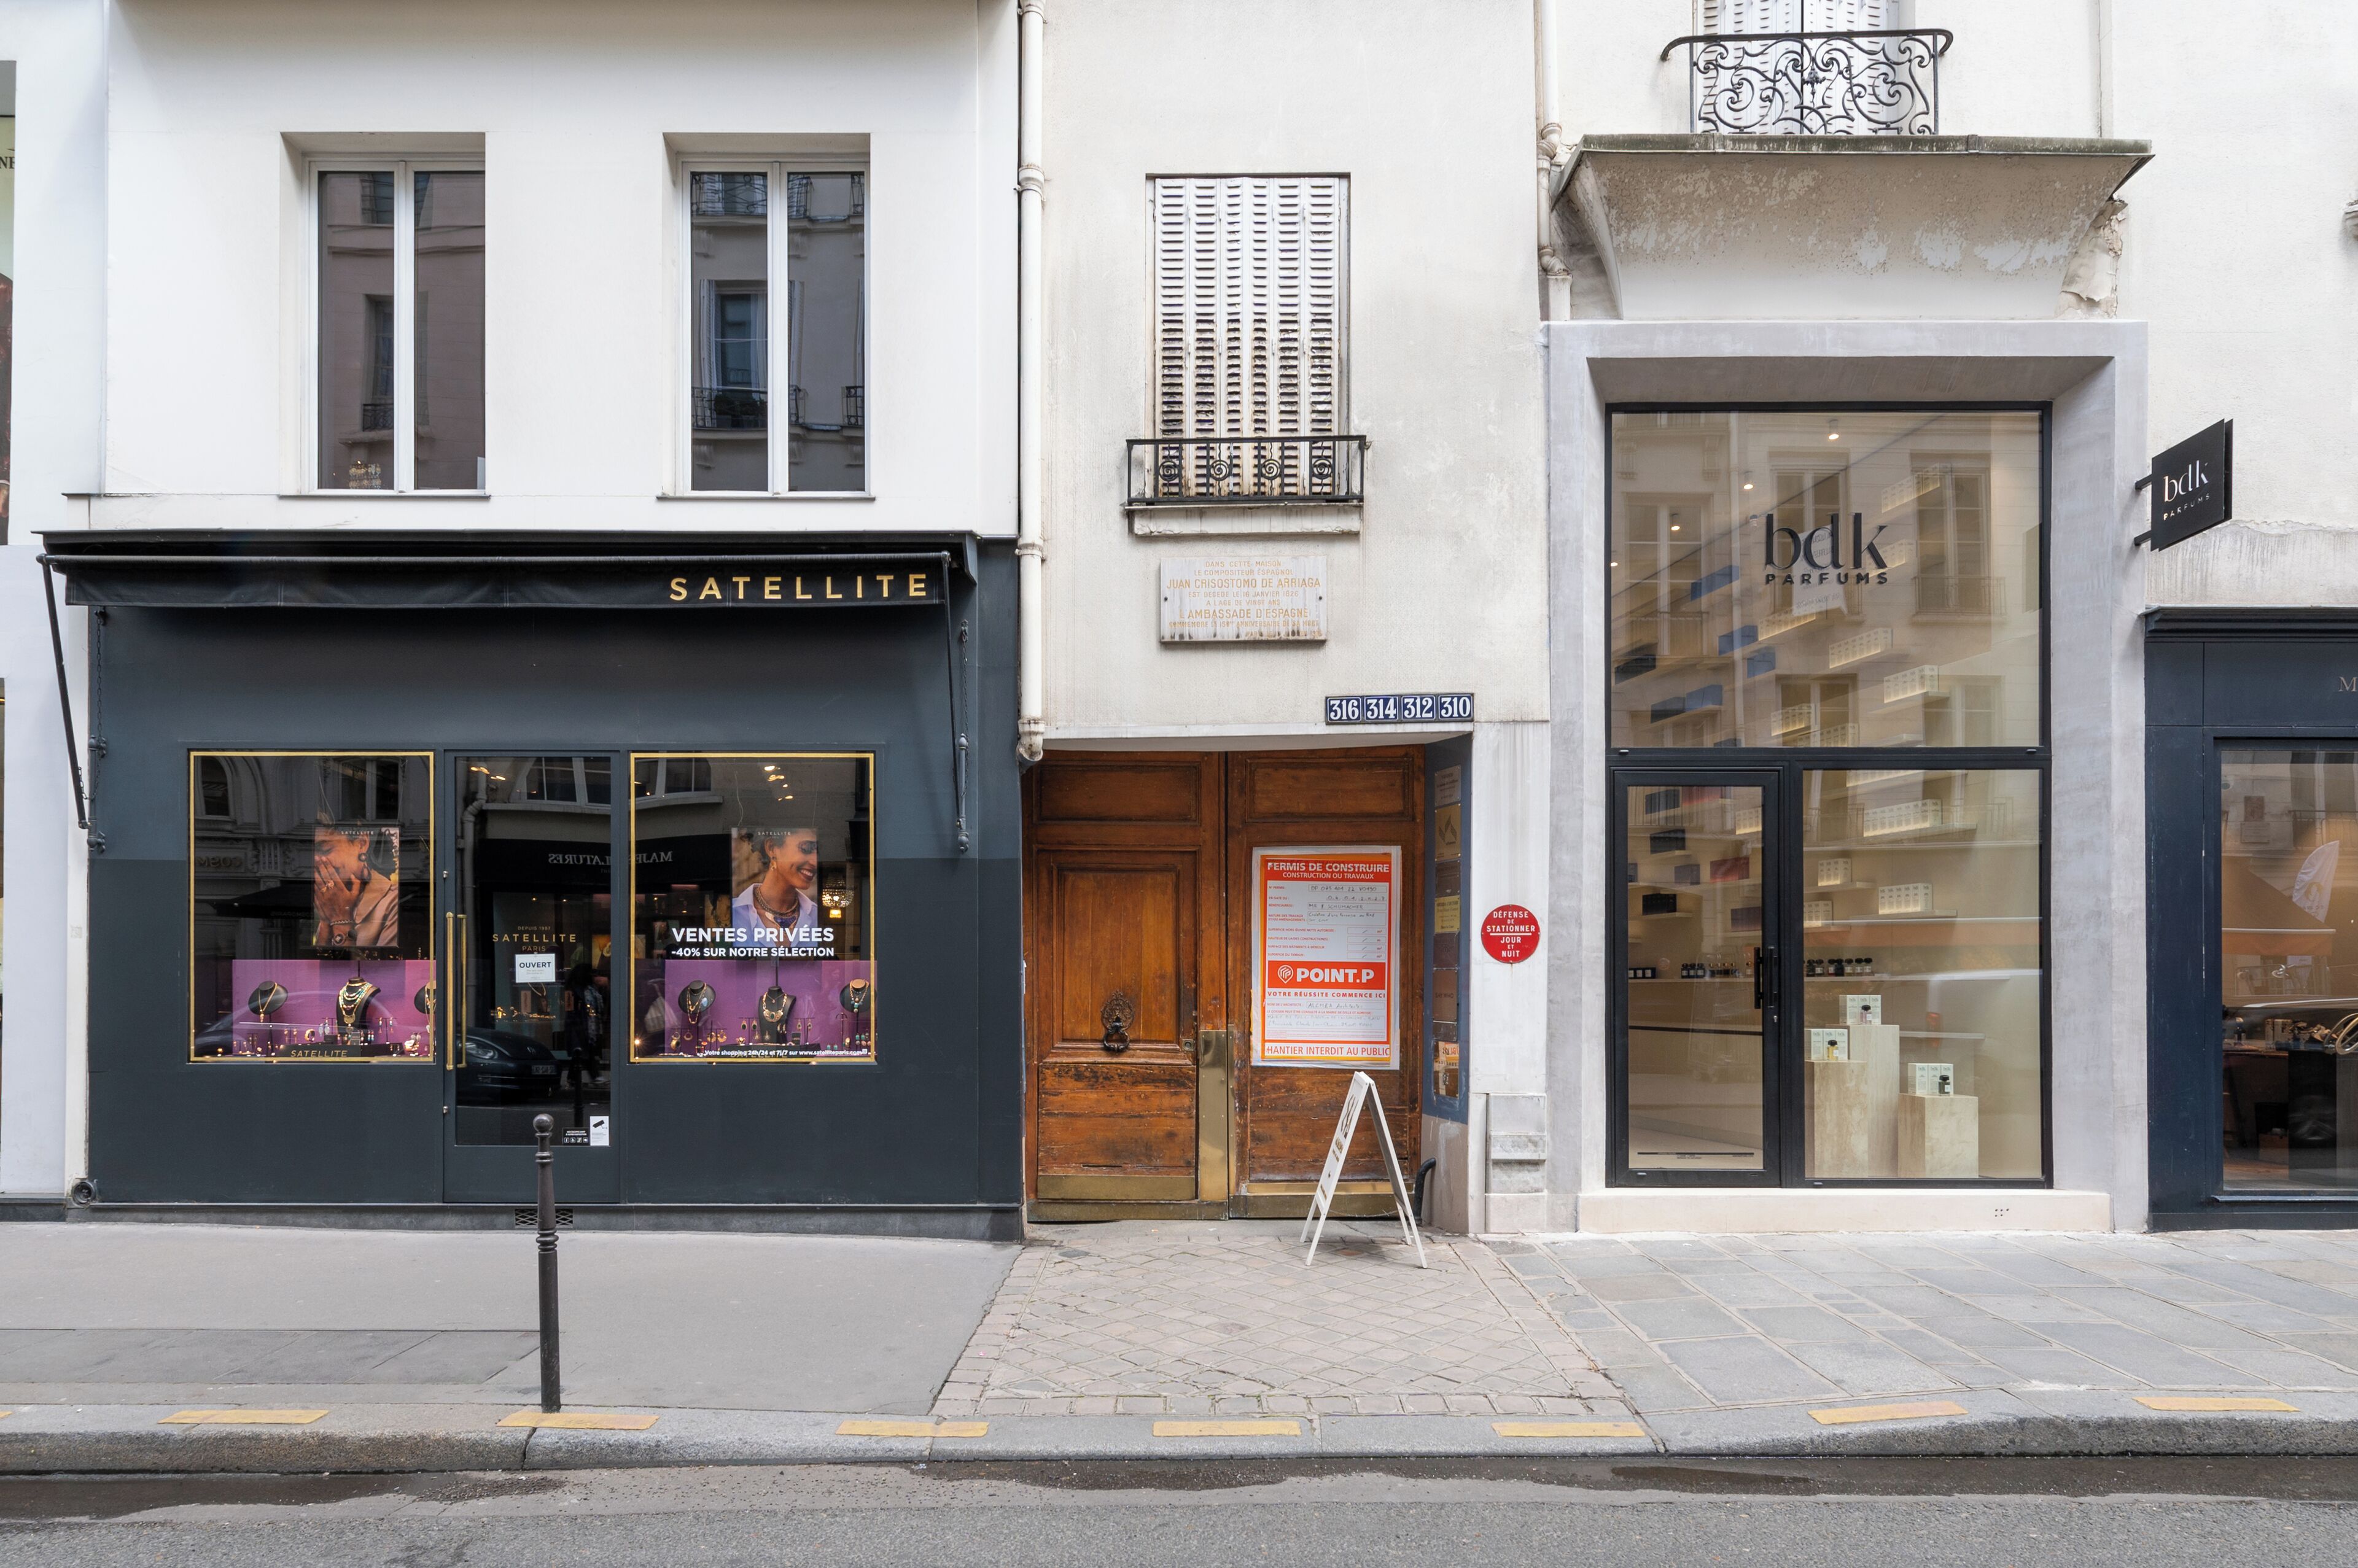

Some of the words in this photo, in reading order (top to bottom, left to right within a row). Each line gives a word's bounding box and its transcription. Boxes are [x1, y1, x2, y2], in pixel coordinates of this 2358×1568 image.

[2163, 459, 2209, 503] bdk
[2163, 493, 2211, 520] PARFUMS
[1764, 512, 1888, 571] bdk
[1167, 579, 1191, 589] JUAN
[1194, 578, 1257, 588] CRISOSTOMO
[1261, 578, 1273, 588] DE
[1277, 578, 1320, 588] ARRIAGA
[1765, 572, 1889, 586] PARFUMS
[669, 573, 928, 602] SATELLITE
[1329, 700, 1359, 721] 316
[1366, 699, 1396, 720] 314
[1404, 698, 1433, 719] 312
[1441, 697, 1471, 718] 310
[1267, 862, 1305, 871] PERMIS
[1309, 863, 1323, 871] DE
[1326, 863, 1390, 872] CONSTRUIRE
[1493, 910, 1528, 918] DÉFENSE
[672, 928, 747, 942] VENTES
[754, 923, 835, 942] PRIVÉES
[672, 947, 700, 957] -40%
[703, 948, 727, 957] SUR
[730, 948, 768, 957] NOTRE
[771, 945, 835, 957] SÉLECTION
[1296, 968, 1374, 983] POINT.P
[1266, 1046, 1303, 1054] HANTIER
[1306, 1046, 1344, 1055] INTERDIT
[1347, 1047, 1358, 1055] AU
